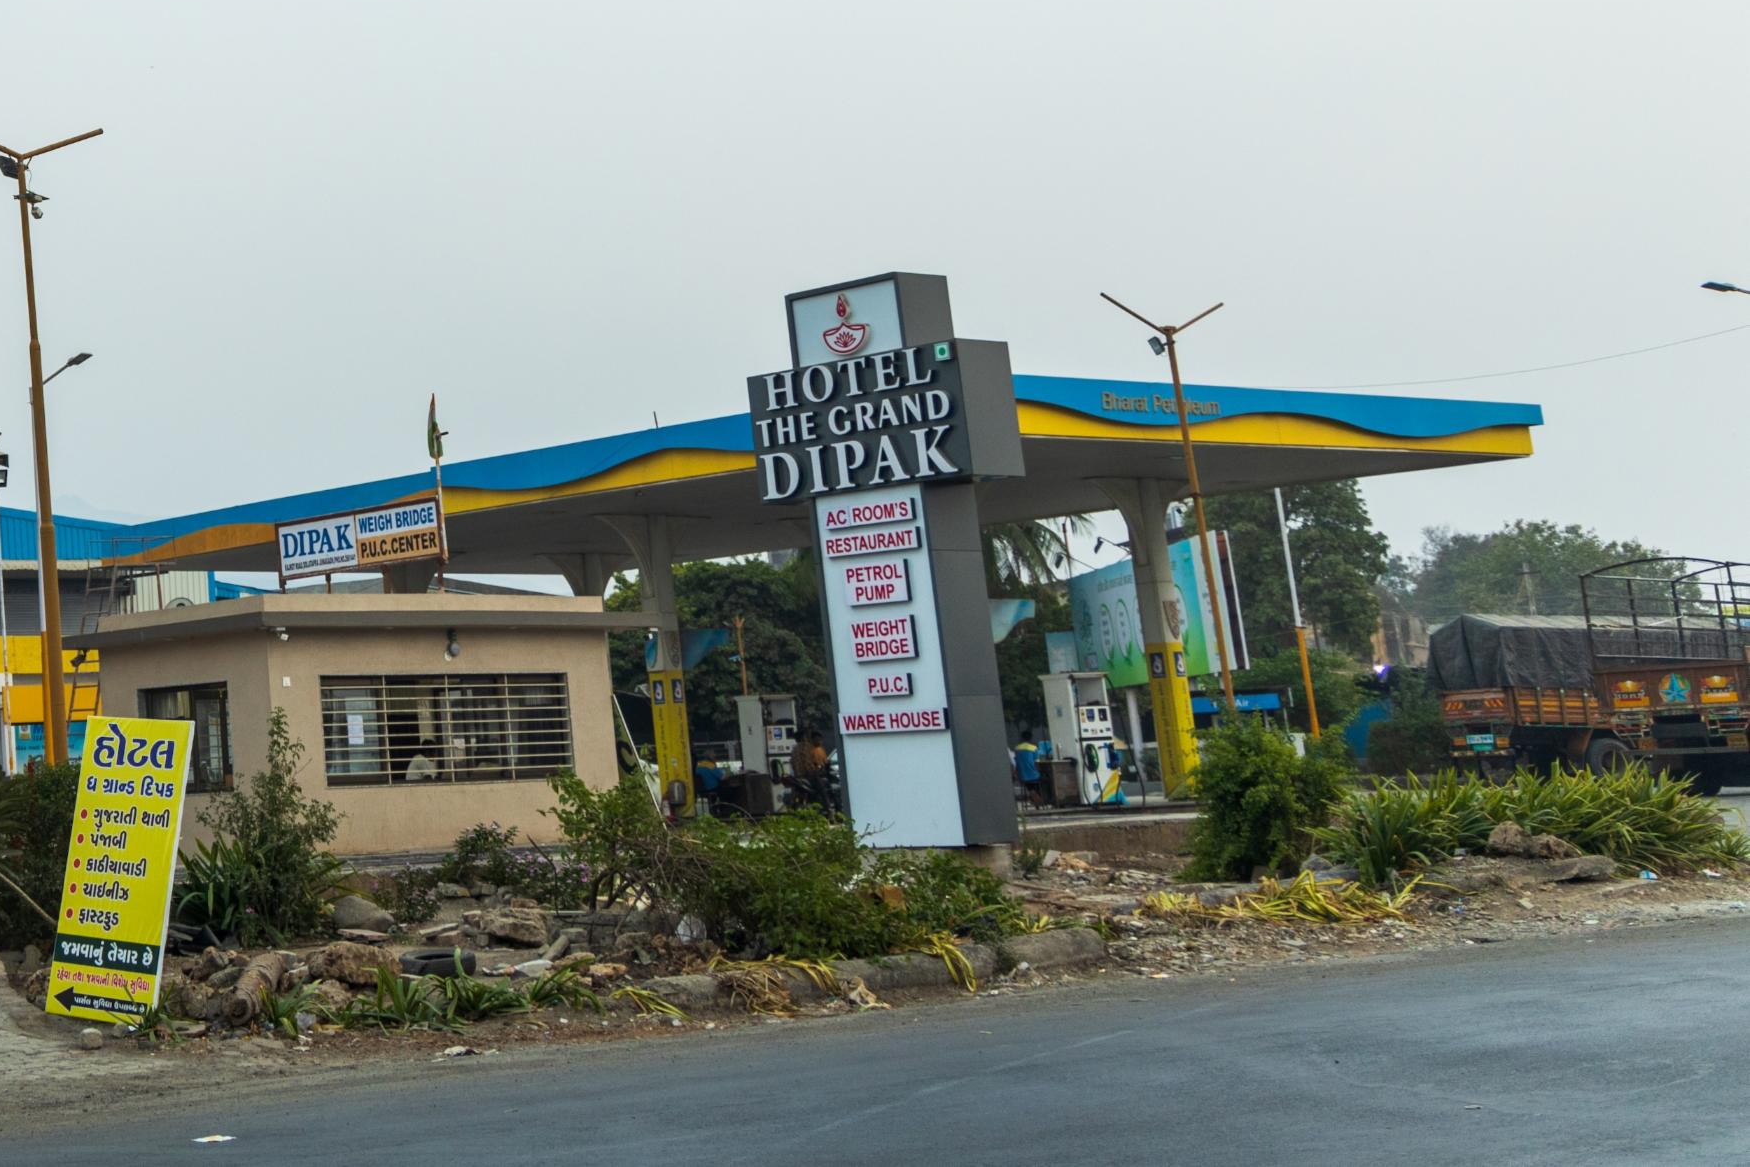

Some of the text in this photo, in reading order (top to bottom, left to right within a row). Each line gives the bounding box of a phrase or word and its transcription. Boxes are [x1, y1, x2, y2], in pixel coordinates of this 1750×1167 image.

[763, 347, 932, 411] HOTEL
[1102, 391, 1221, 415] Bharat Petleum
[755, 389, 950, 448] THE GRAND
[759, 425, 958, 501] DIPAK
[358, 507, 435, 534] WEIGH BRIDGE
[826, 502, 908, 526] AC ROOM'S
[282, 524, 353, 558] DIPAK
[826, 530, 913, 554] RESTAURANT
[846, 564, 902, 583] PETROL
[855, 584, 895, 602] PUMP
[851, 619, 907, 638] WEIGHT
[855, 639, 909, 658] BRIDGE
[868, 677, 908, 694] P.U.C.
[843, 711, 941, 731] WARE HOUSE
[94, 723, 174, 769] હોટલ
[103, 779, 135, 794] ગ્રાન્ડ
[141, 775, 174, 798] દિપક
[94, 806, 170, 828] ગુજરાતી થાળી
[91, 829, 127, 849] પંજાબી
[86, 854, 146, 877] કાઠીયાવાડી
[61, 941, 153, 966] જમવાનું તૈયાર છે
